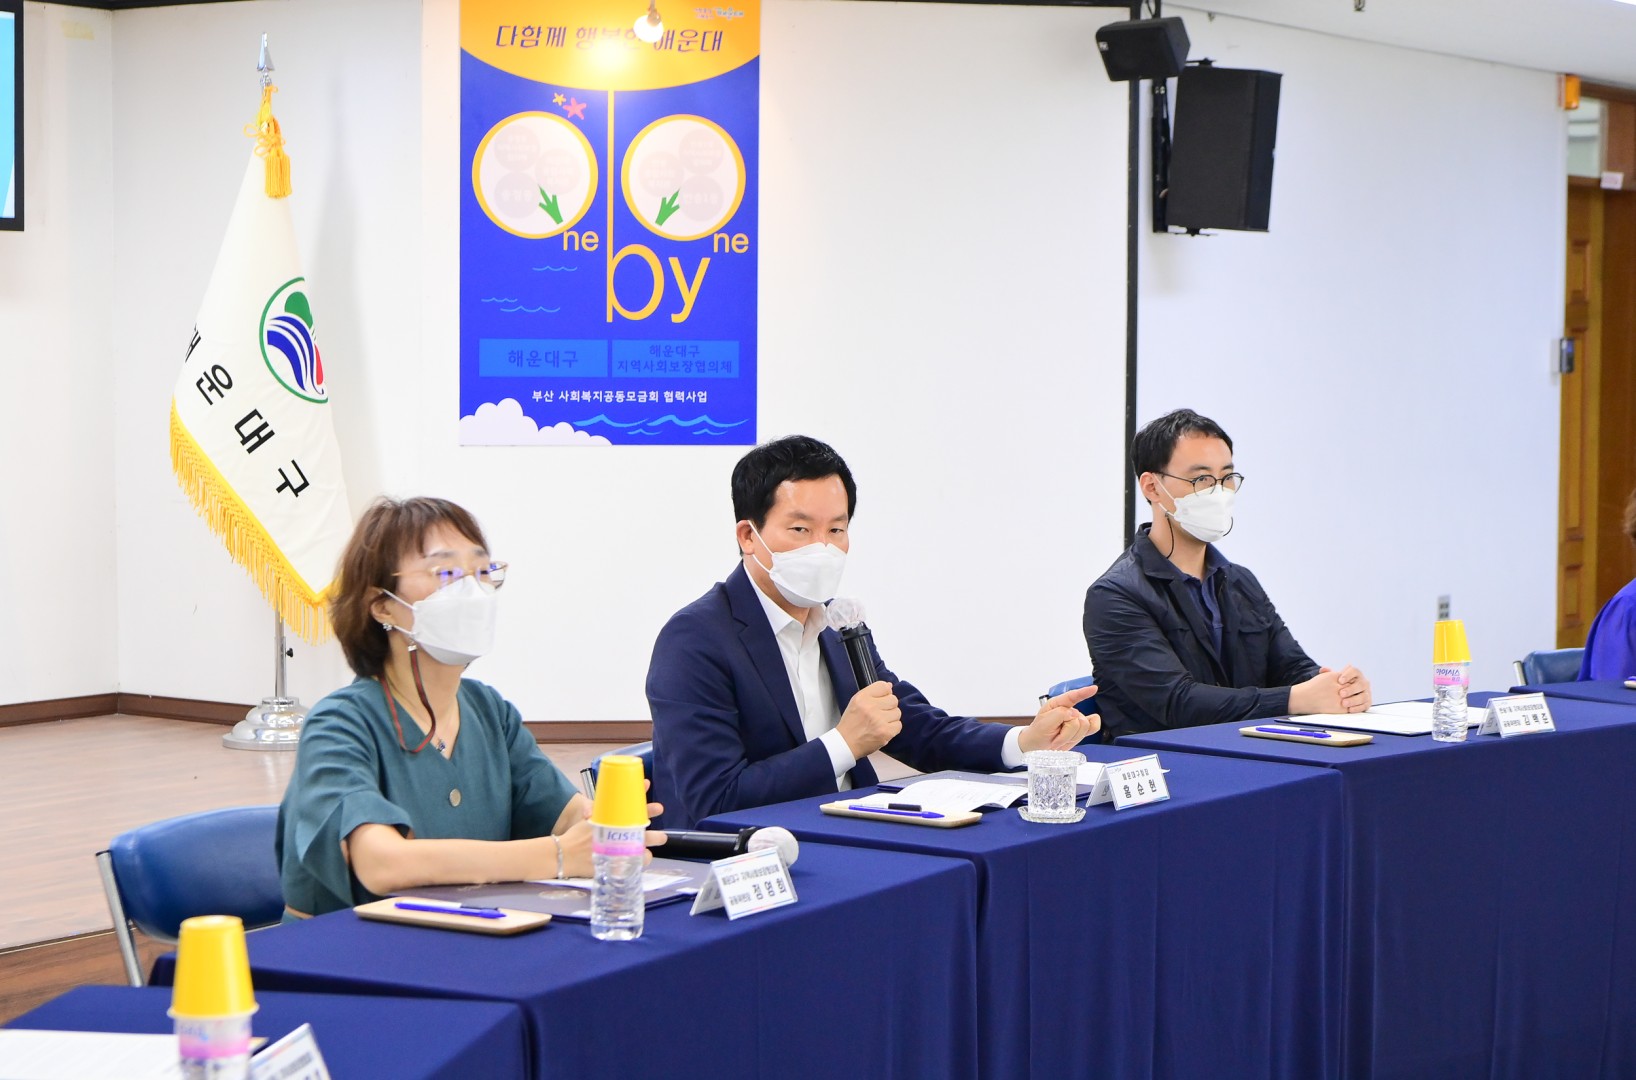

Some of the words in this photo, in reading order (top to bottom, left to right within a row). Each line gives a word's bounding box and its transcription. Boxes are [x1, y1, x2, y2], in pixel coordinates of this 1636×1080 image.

[496, 25, 567, 48] 다함께
[649, 344, 700, 358] 해운대구
[508, 350, 579, 368] 해운대구
[532, 390, 554, 402] 부산
[558, 390, 660, 403] 사회복지공동모금회
[663, 391, 708, 403] 협력사업
[1436, 668, 1460, 676] 아이시스
